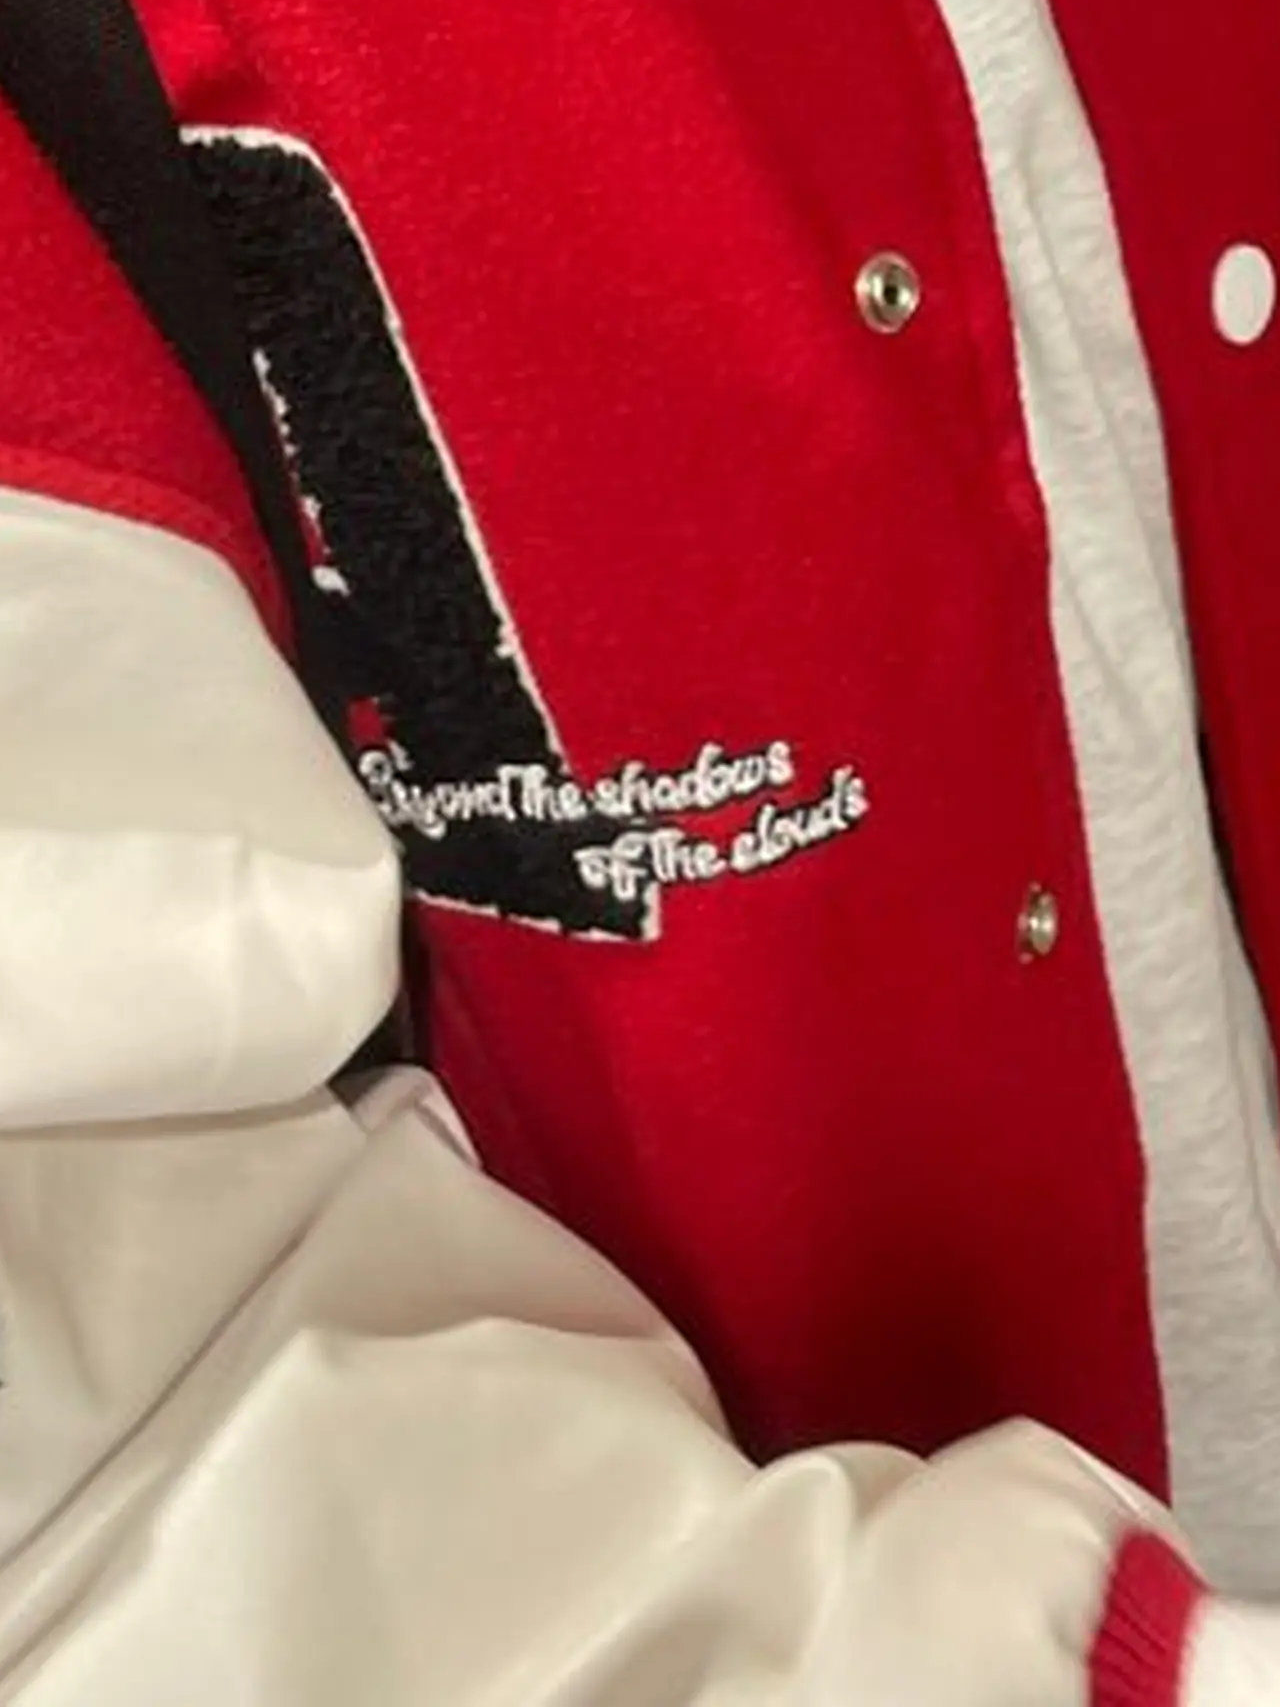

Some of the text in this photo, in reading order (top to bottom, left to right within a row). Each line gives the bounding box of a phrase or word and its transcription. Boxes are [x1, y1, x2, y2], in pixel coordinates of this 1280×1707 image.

[592, 740, 796, 816] shadows
[572, 831, 652, 902] of
[730, 764, 870, 873] clouds
